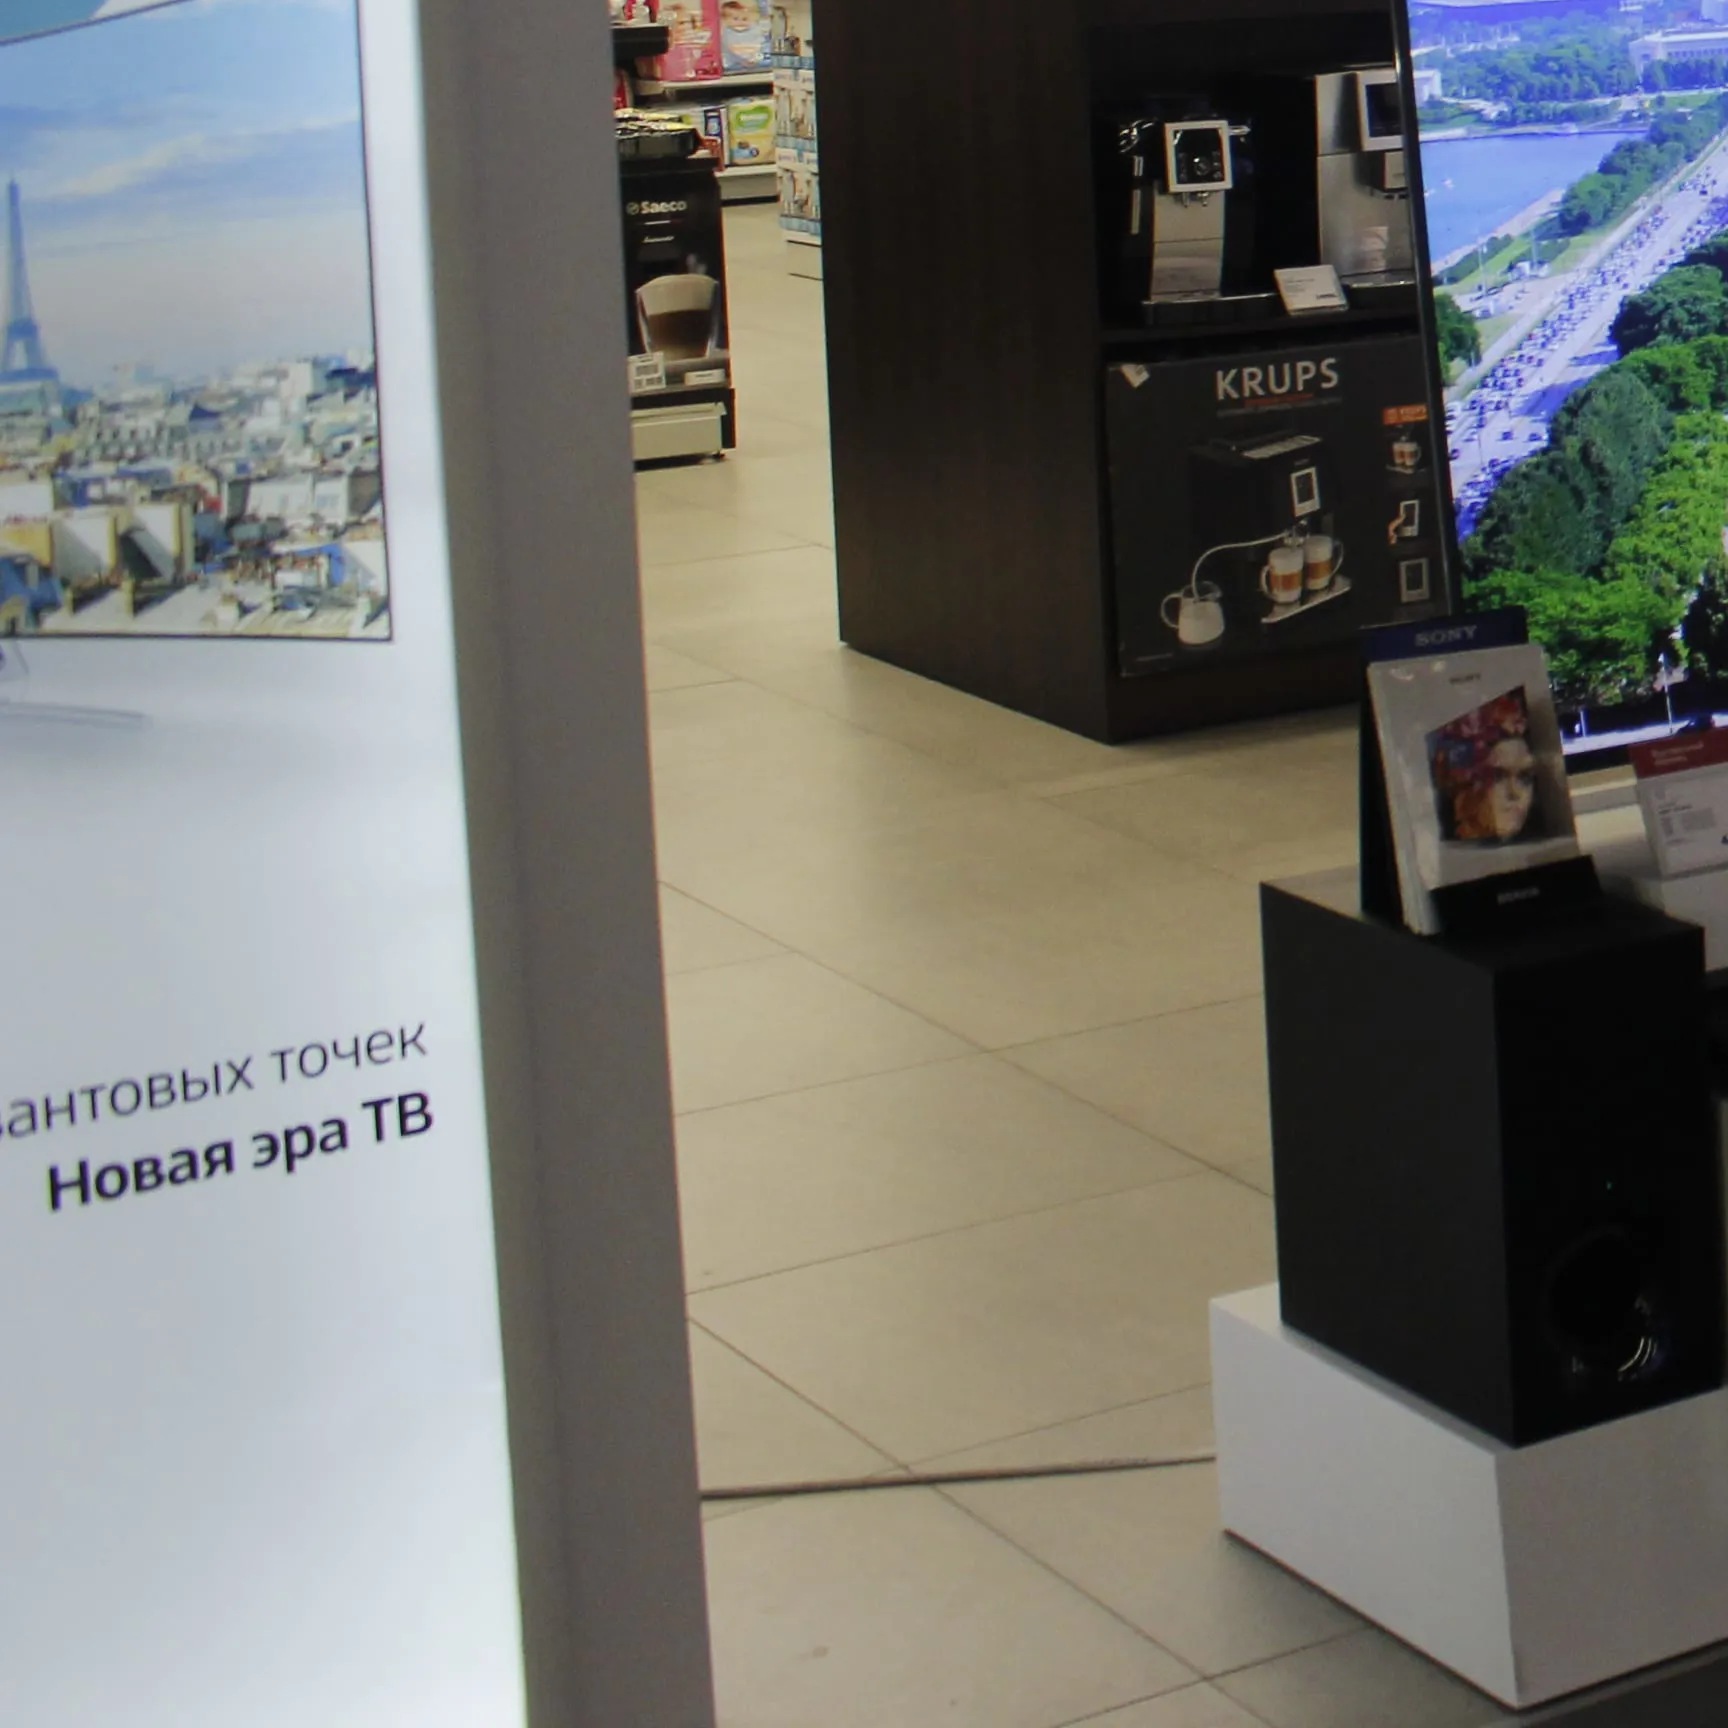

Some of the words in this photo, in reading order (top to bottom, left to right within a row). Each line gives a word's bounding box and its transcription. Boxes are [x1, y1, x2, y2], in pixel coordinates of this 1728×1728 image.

[640, 199, 687, 214] Saeco
[1215, 356, 1339, 403] KRUPS
[1414, 623, 1478, 648] SONY
[269, 1022, 429, 1083] точек
[48, 1139, 235, 1212] Новая
[251, 1116, 349, 1175] эра
[362, 1091, 434, 1143] ТВ
